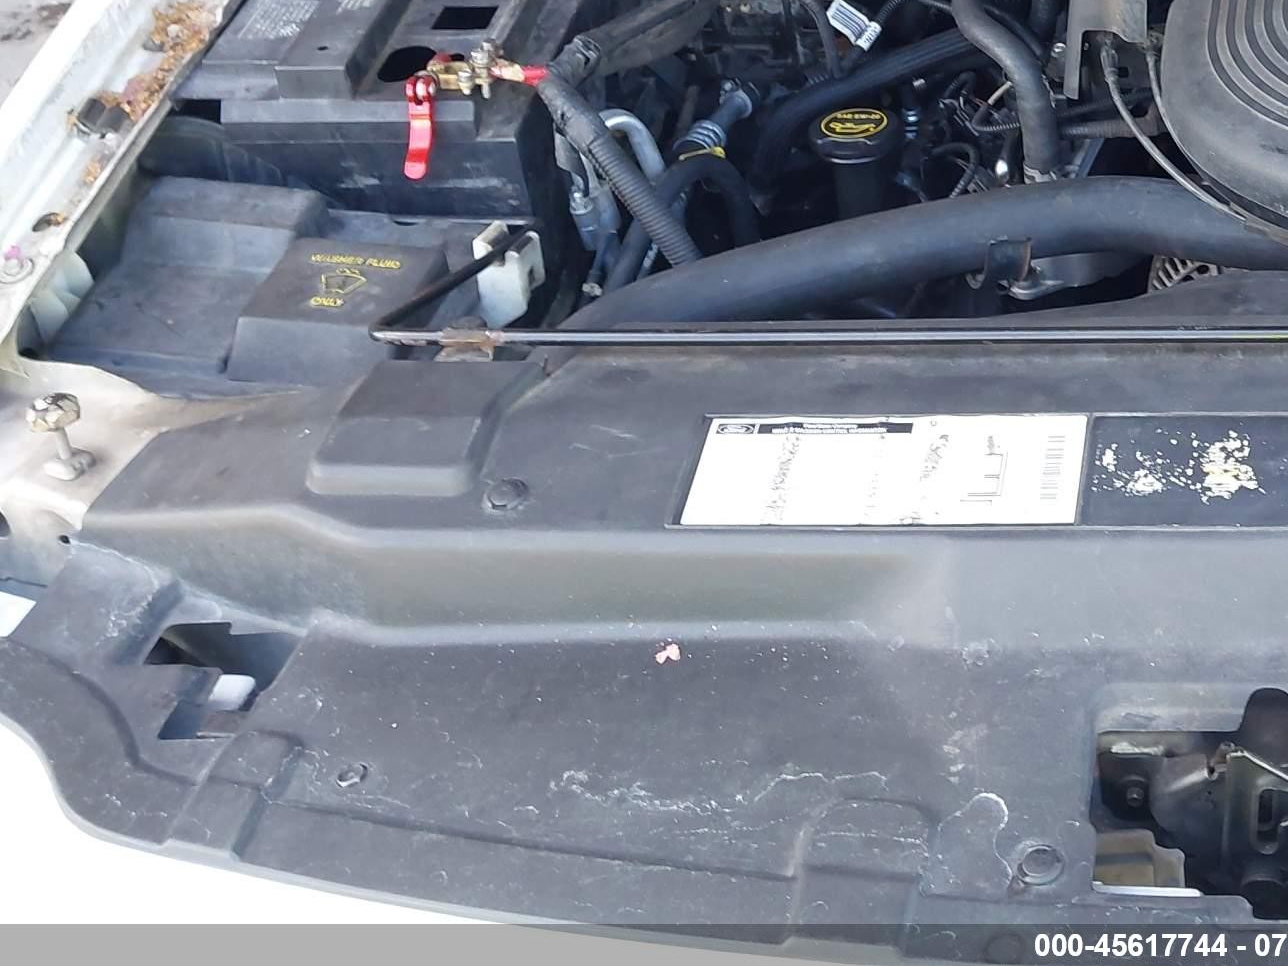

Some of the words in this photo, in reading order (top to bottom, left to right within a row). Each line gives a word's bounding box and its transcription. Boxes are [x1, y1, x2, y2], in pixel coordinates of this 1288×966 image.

[310, 253, 365, 265] WASHER
[365, 257, 401, 269] FLUID
[310, 296, 345, 307] ONLY
